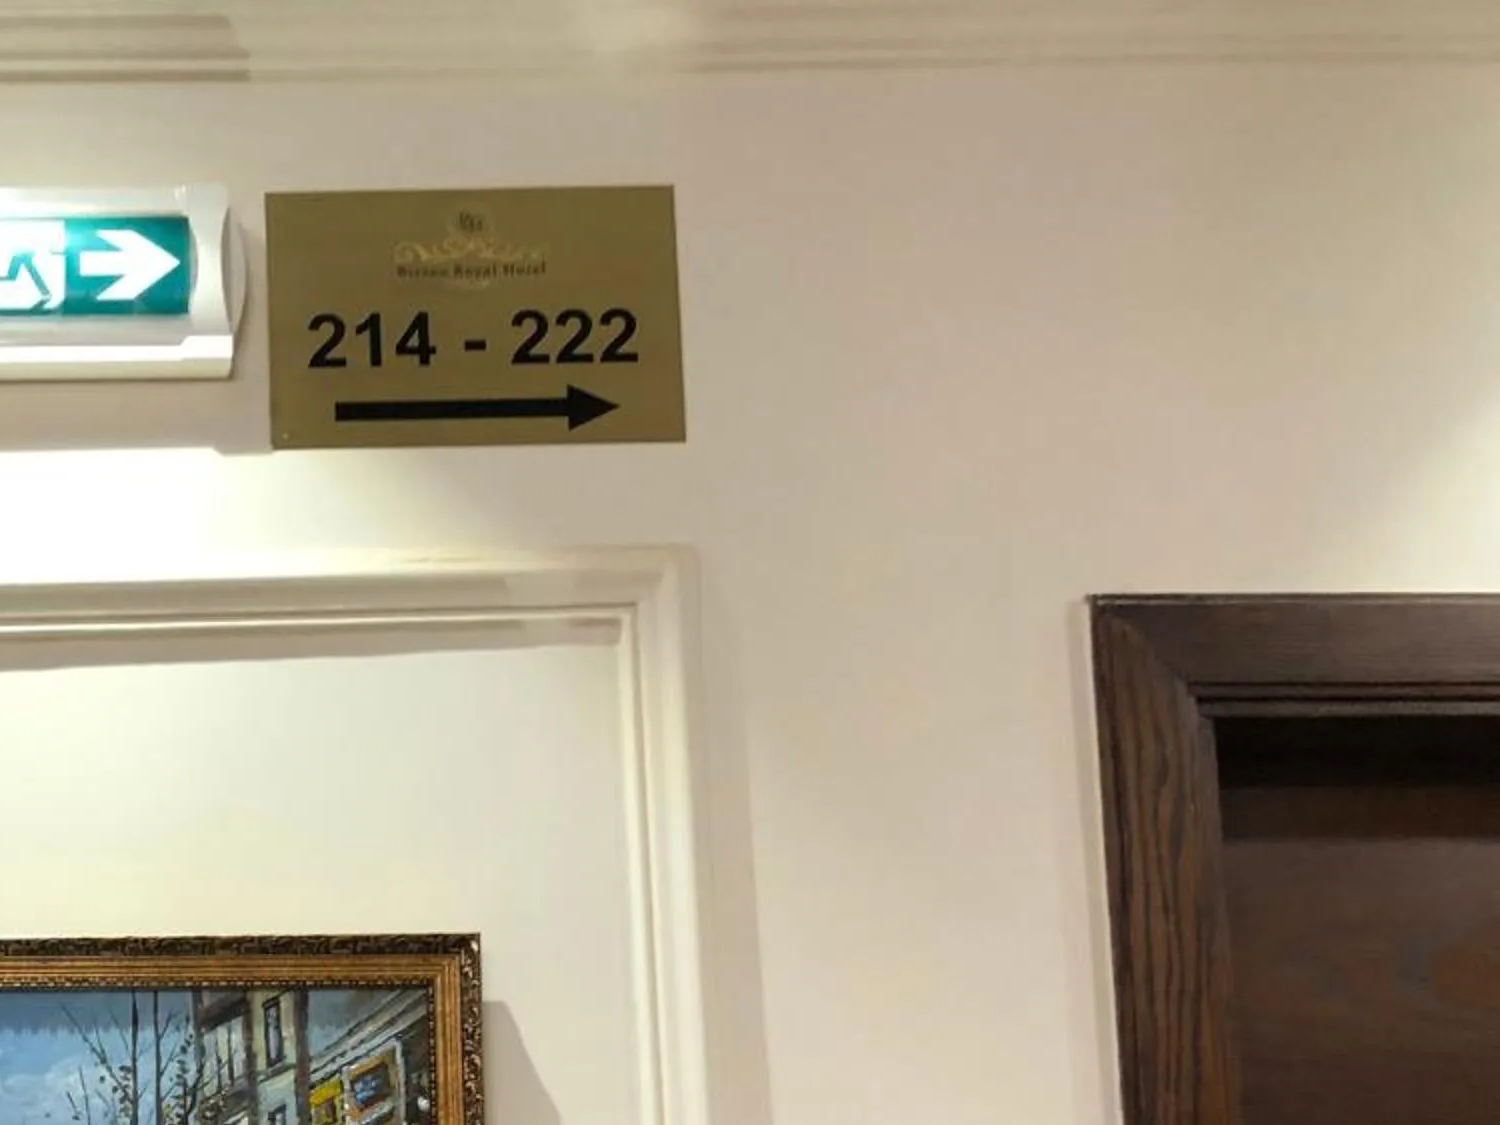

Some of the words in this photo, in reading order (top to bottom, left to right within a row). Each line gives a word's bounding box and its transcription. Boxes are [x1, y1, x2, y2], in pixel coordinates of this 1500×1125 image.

[502, 259, 546, 277] Hotel
[307, 311, 436, 368] 214
[464, 339, 487, 352] -
[510, 308, 639, 365] 222
